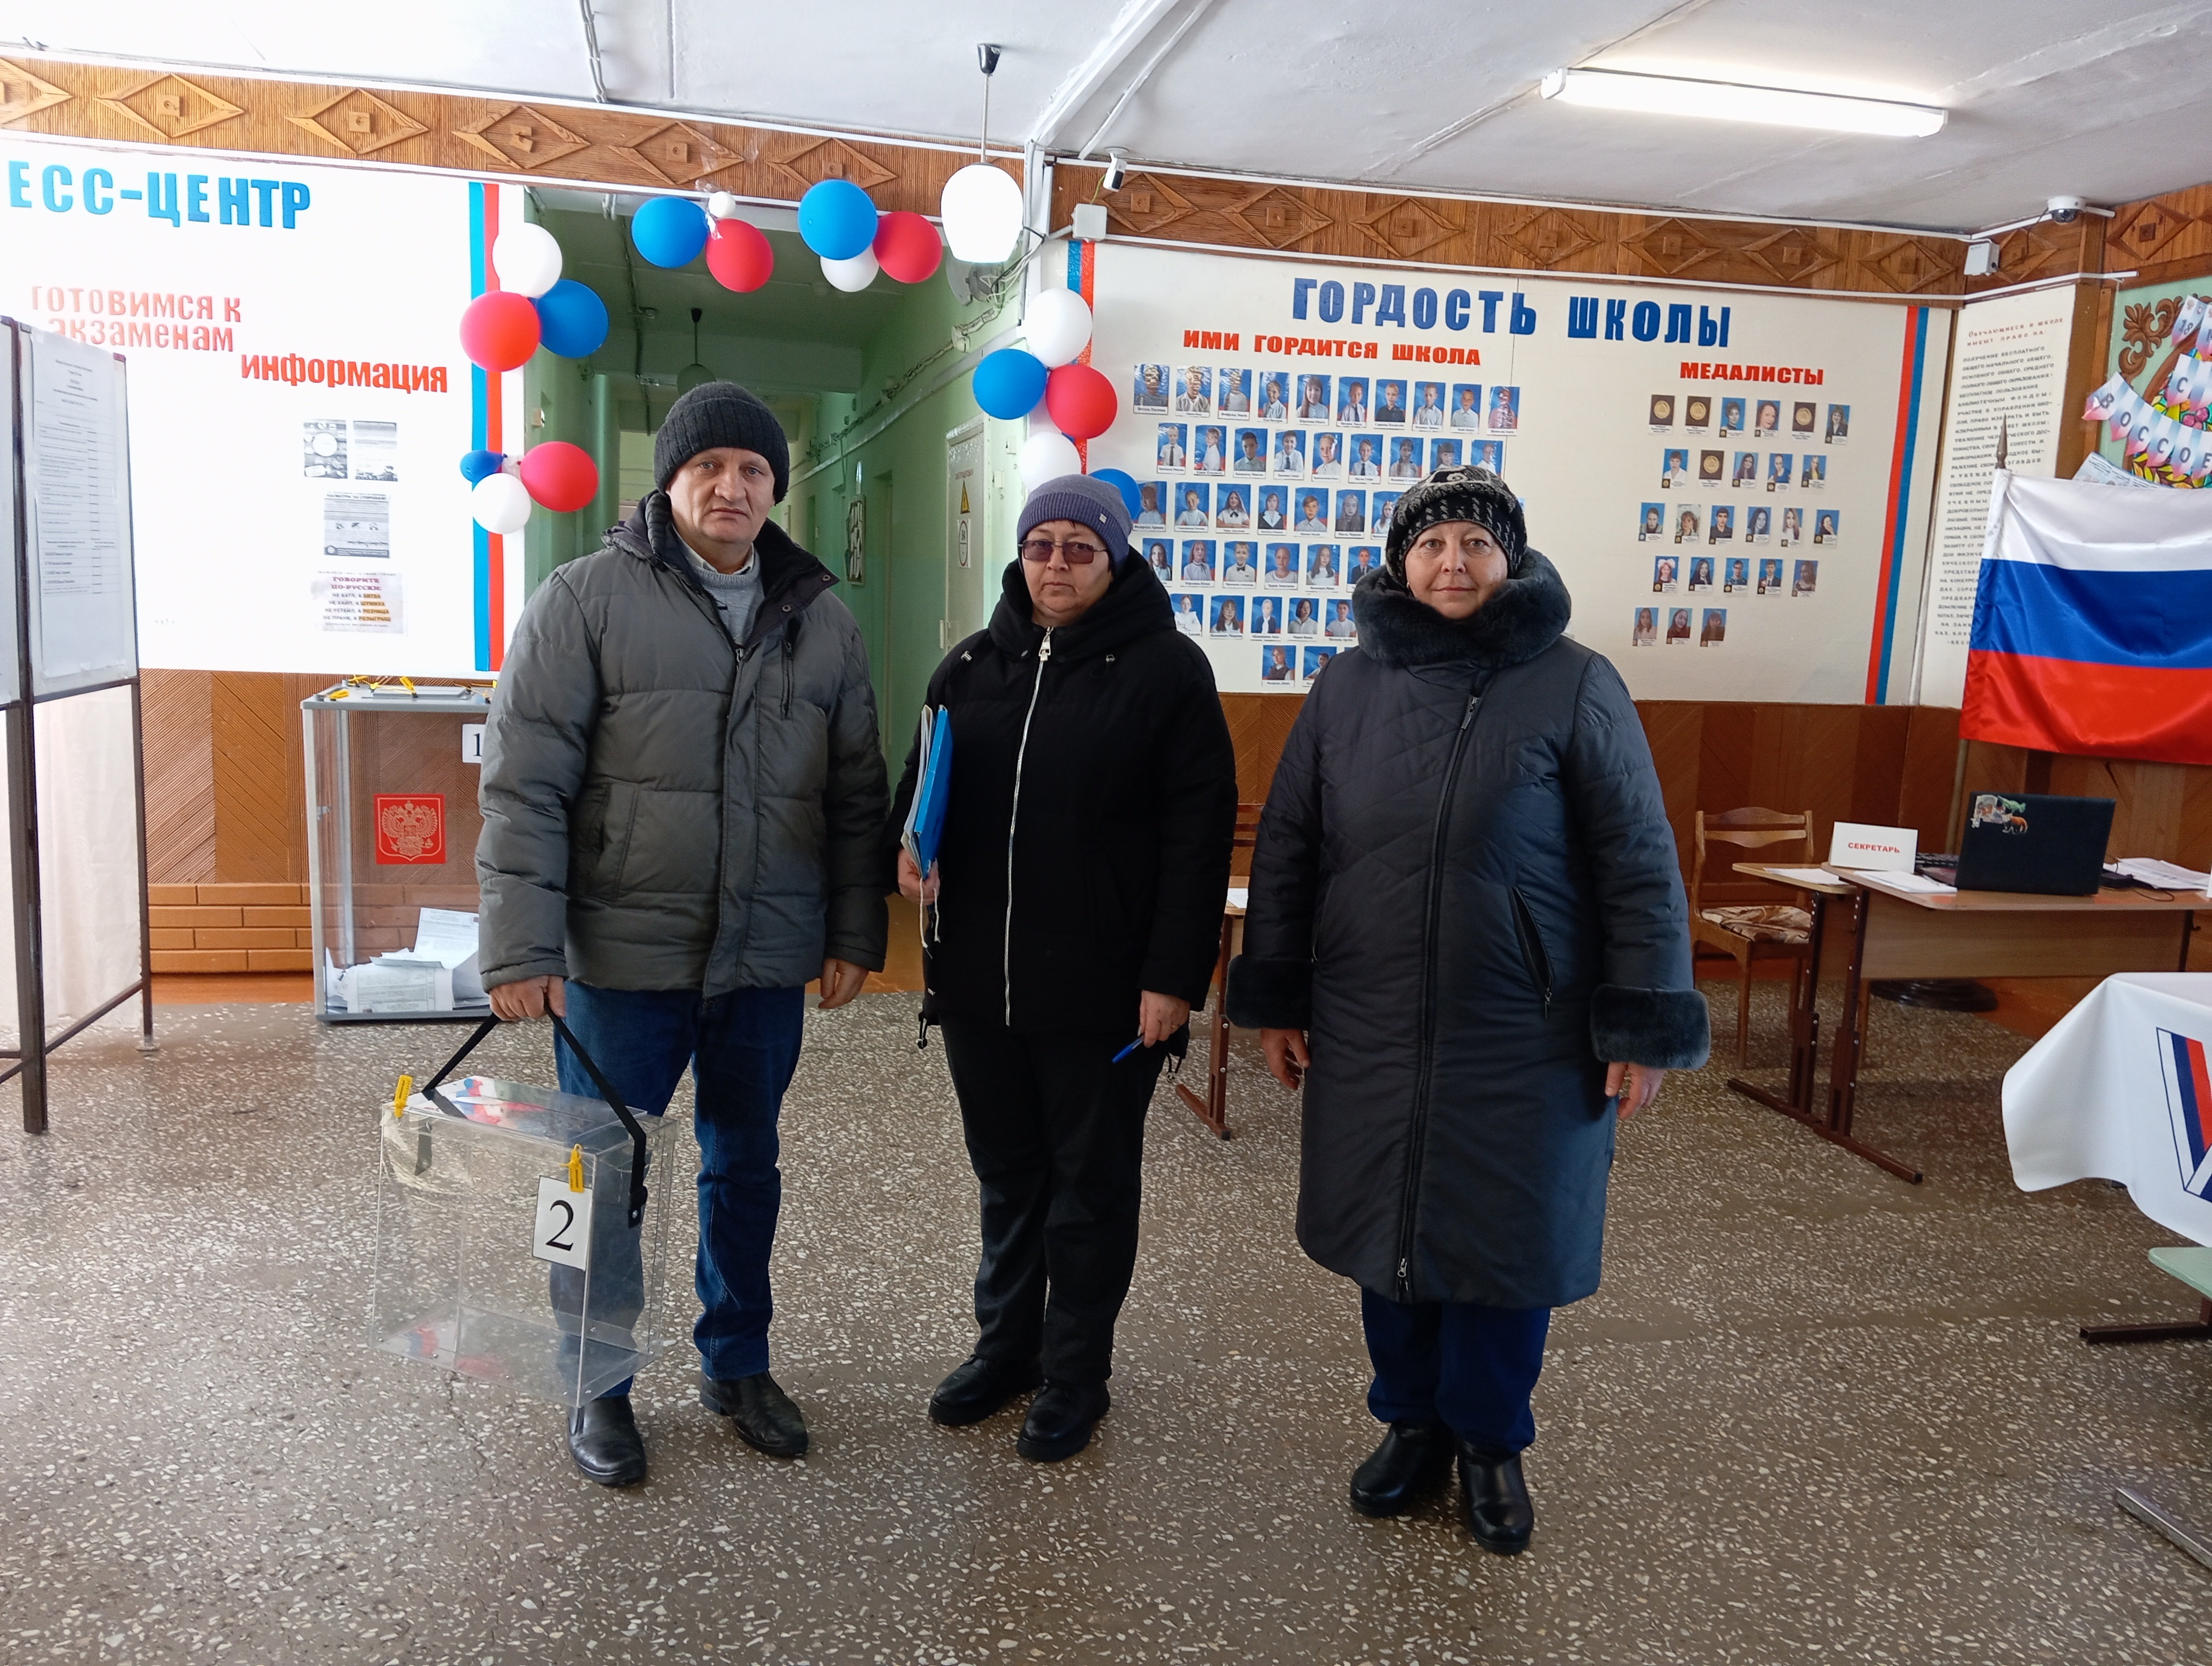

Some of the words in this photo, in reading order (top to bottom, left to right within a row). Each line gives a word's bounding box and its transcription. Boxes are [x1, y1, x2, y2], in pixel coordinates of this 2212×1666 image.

[9, 160, 311, 229] ЕСС-ЦЕНТР
[1293, 277, 1536, 335] ГОРДОСТЬ
[1567, 296, 1731, 347] ШКОЛЫ
[2001, 333, 2028, 341] ПРАВО
[2178, 319, 2194, 335] 18
[1183, 330, 1239, 351] ИМИ
[1253, 334, 1379, 360] ГОРДИТСЯ
[1392, 343, 1481, 366] ШКОЛА
[1963, 353, 1998, 362] ПОЛУЧЕНИЕ
[2001, 346, 2045, 356] БЕСПЛАТНОГО
[1986, 358, 2024, 368] НАЧАЛЬНОГО
[2023, 363, 2054, 371] СРЕДНЕГО
[241, 353, 447, 394] информация
[1680, 362, 1824, 386] МЕДАЛИСТЫ
[1994, 403, 2035, 412] УПРАВЛЕНИИ
[473, 733, 483, 757] 1
[1848, 842, 1900, 853] СЕКРЕТАРЬ
[545, 1199, 575, 1252] 2
